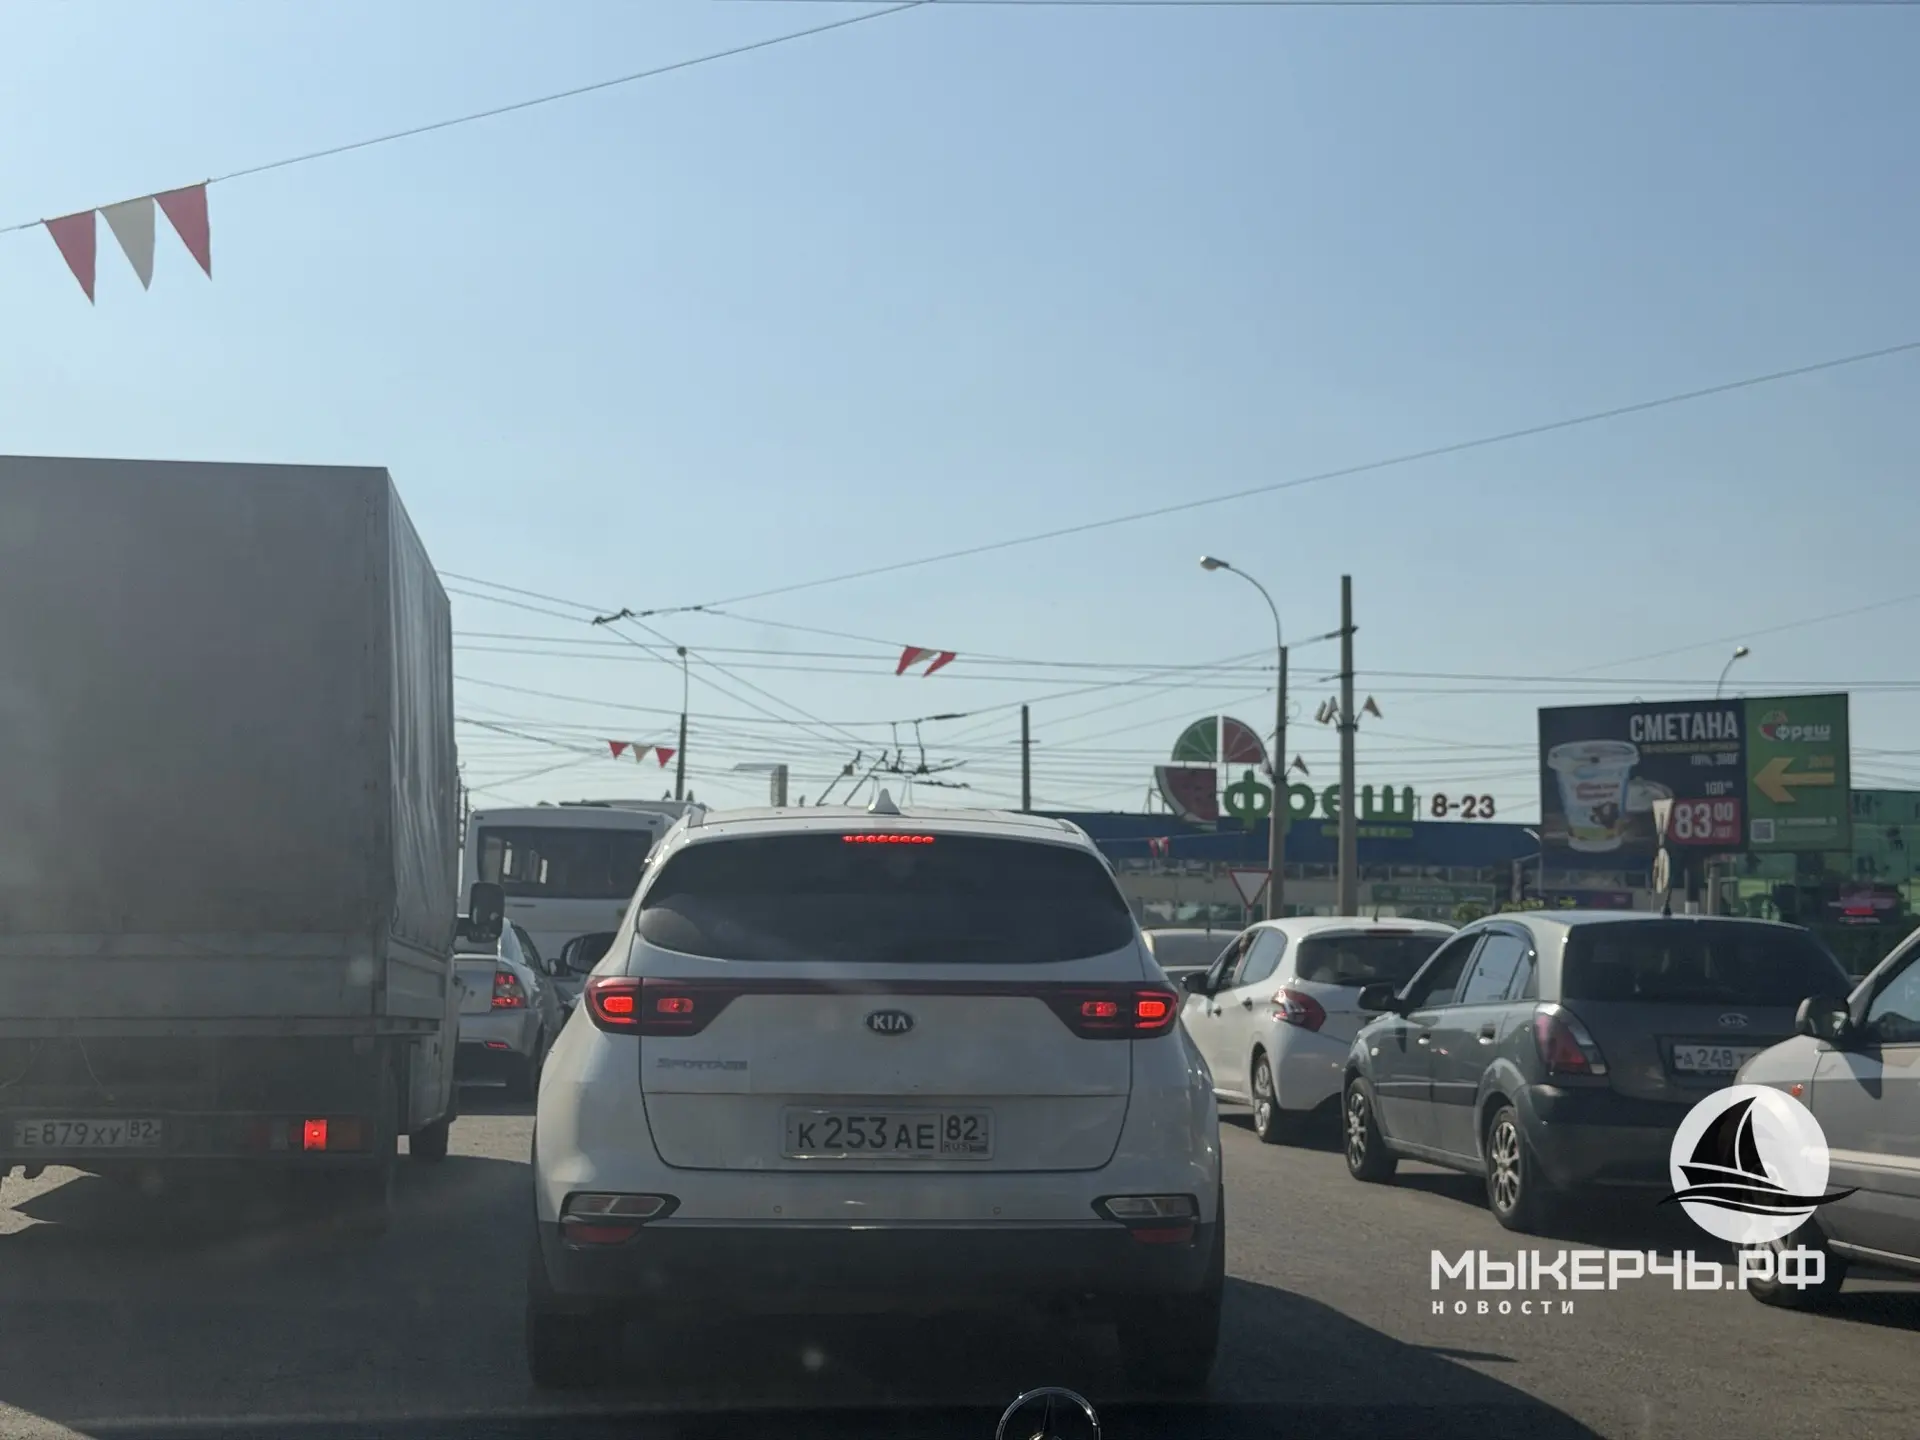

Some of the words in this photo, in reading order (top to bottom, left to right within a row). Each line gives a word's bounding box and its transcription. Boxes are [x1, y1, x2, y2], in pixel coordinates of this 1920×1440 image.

[1630, 711, 1739, 741] СМЕТАНА
[1431, 793, 1496, 819] 8-23
[1674, 803, 1712, 839] 83
[873, 1015, 908, 1029] KIA
[946, 1115, 979, 1141] 82
